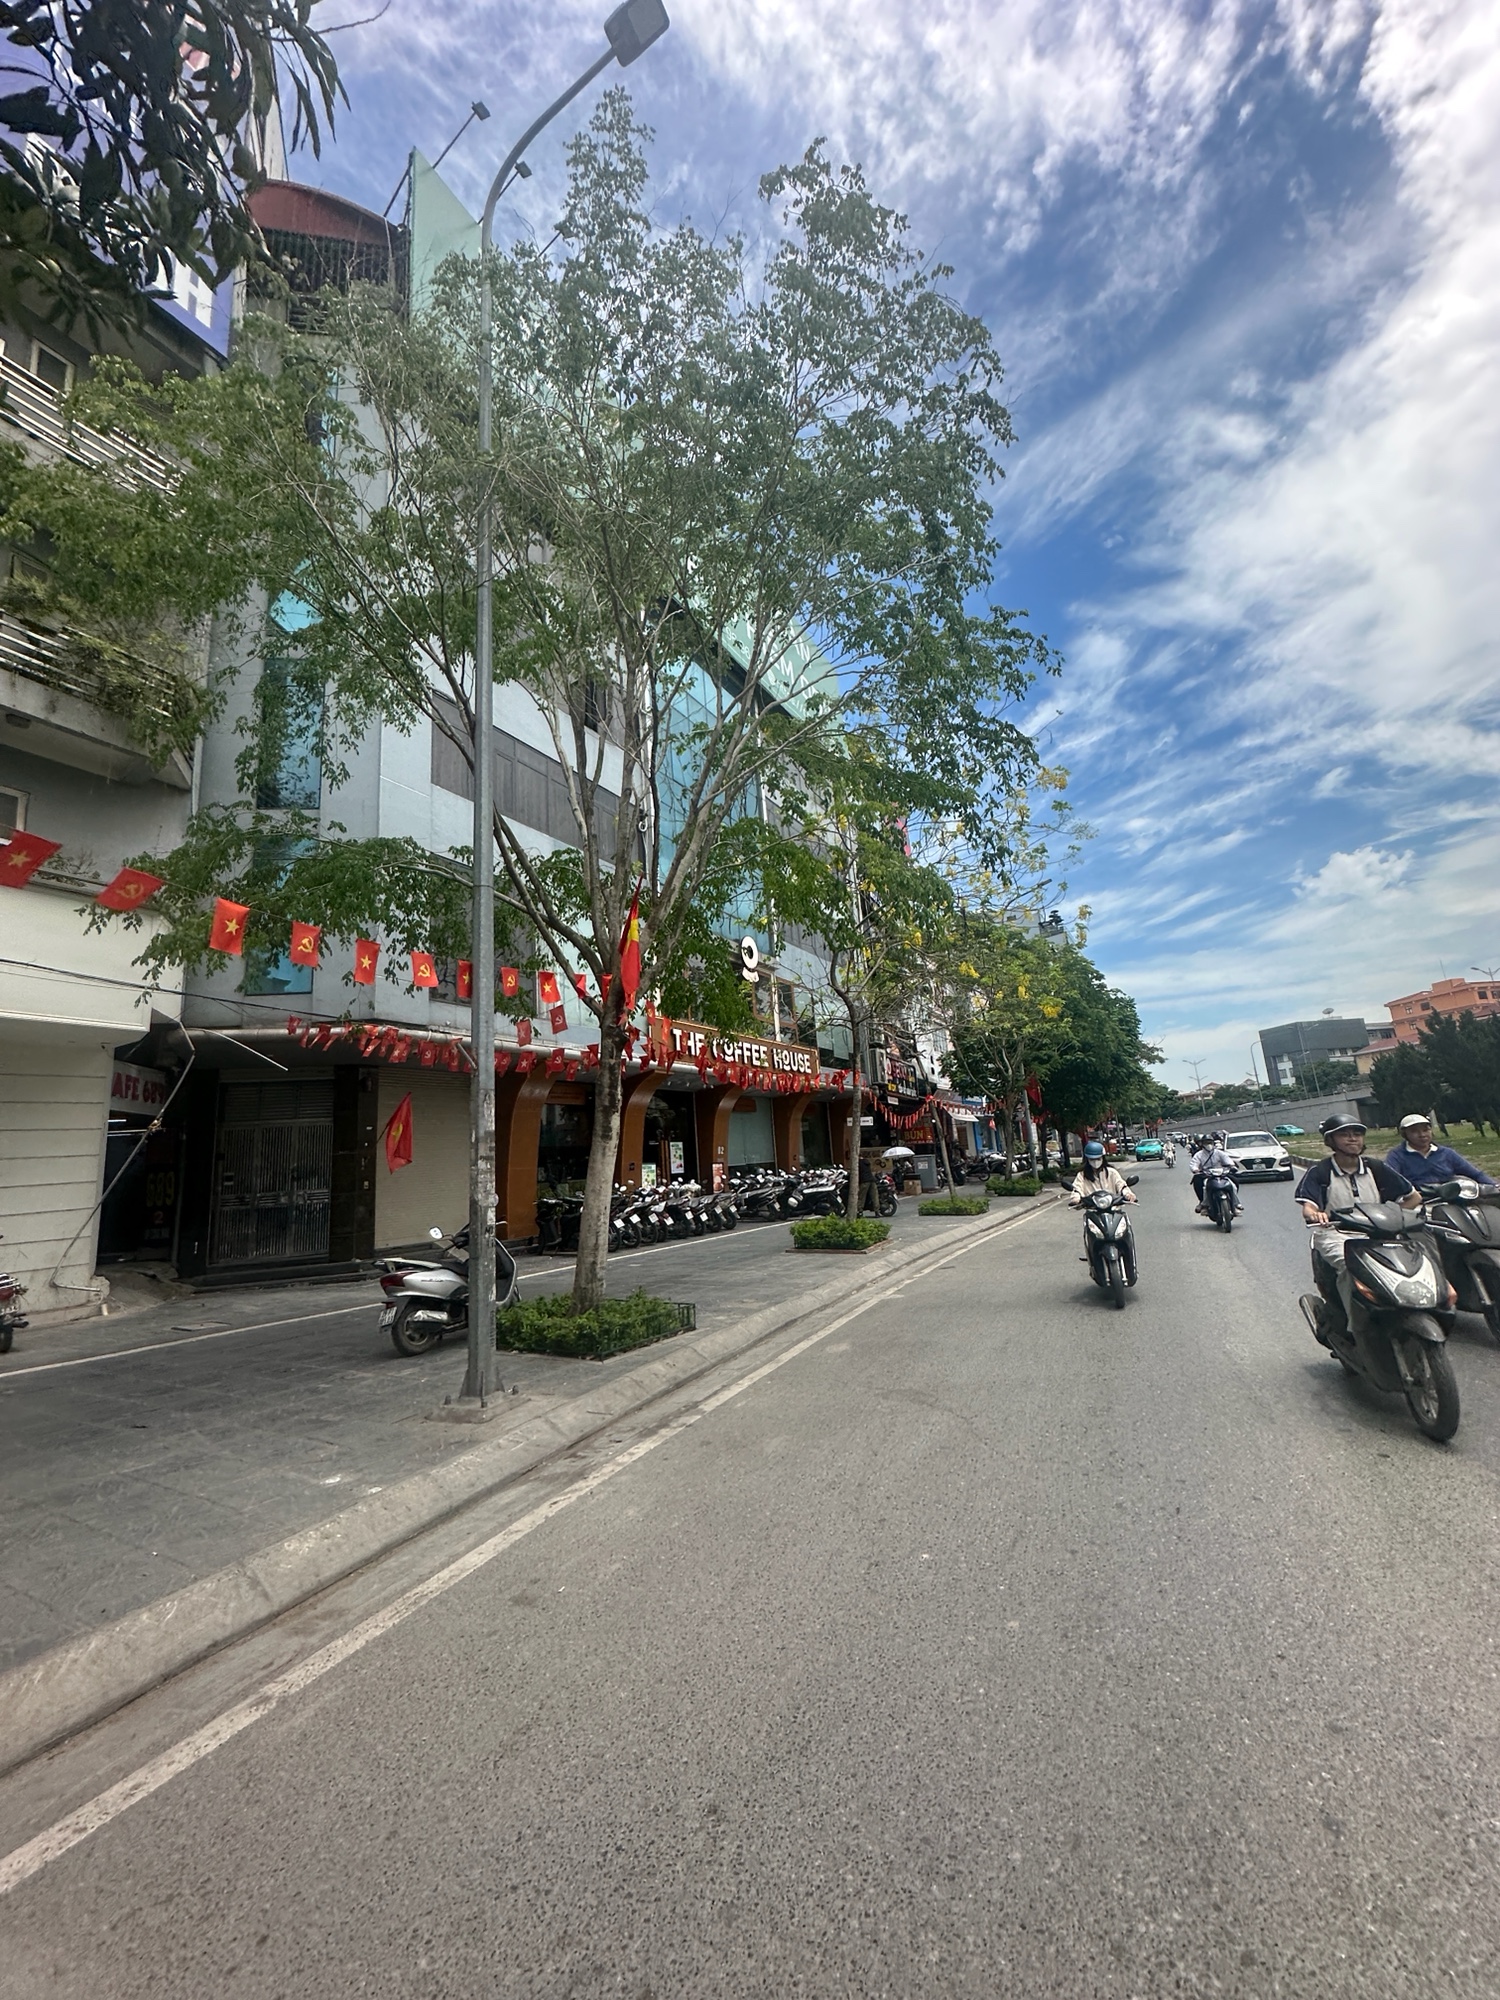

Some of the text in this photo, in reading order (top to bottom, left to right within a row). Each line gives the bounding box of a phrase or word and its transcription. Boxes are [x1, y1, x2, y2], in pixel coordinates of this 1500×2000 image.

[673, 1028, 812, 1073] THE COFFEE HOUSE
[112, 1071, 140, 1101] AFE
[146, 1171, 175, 1207] 689
